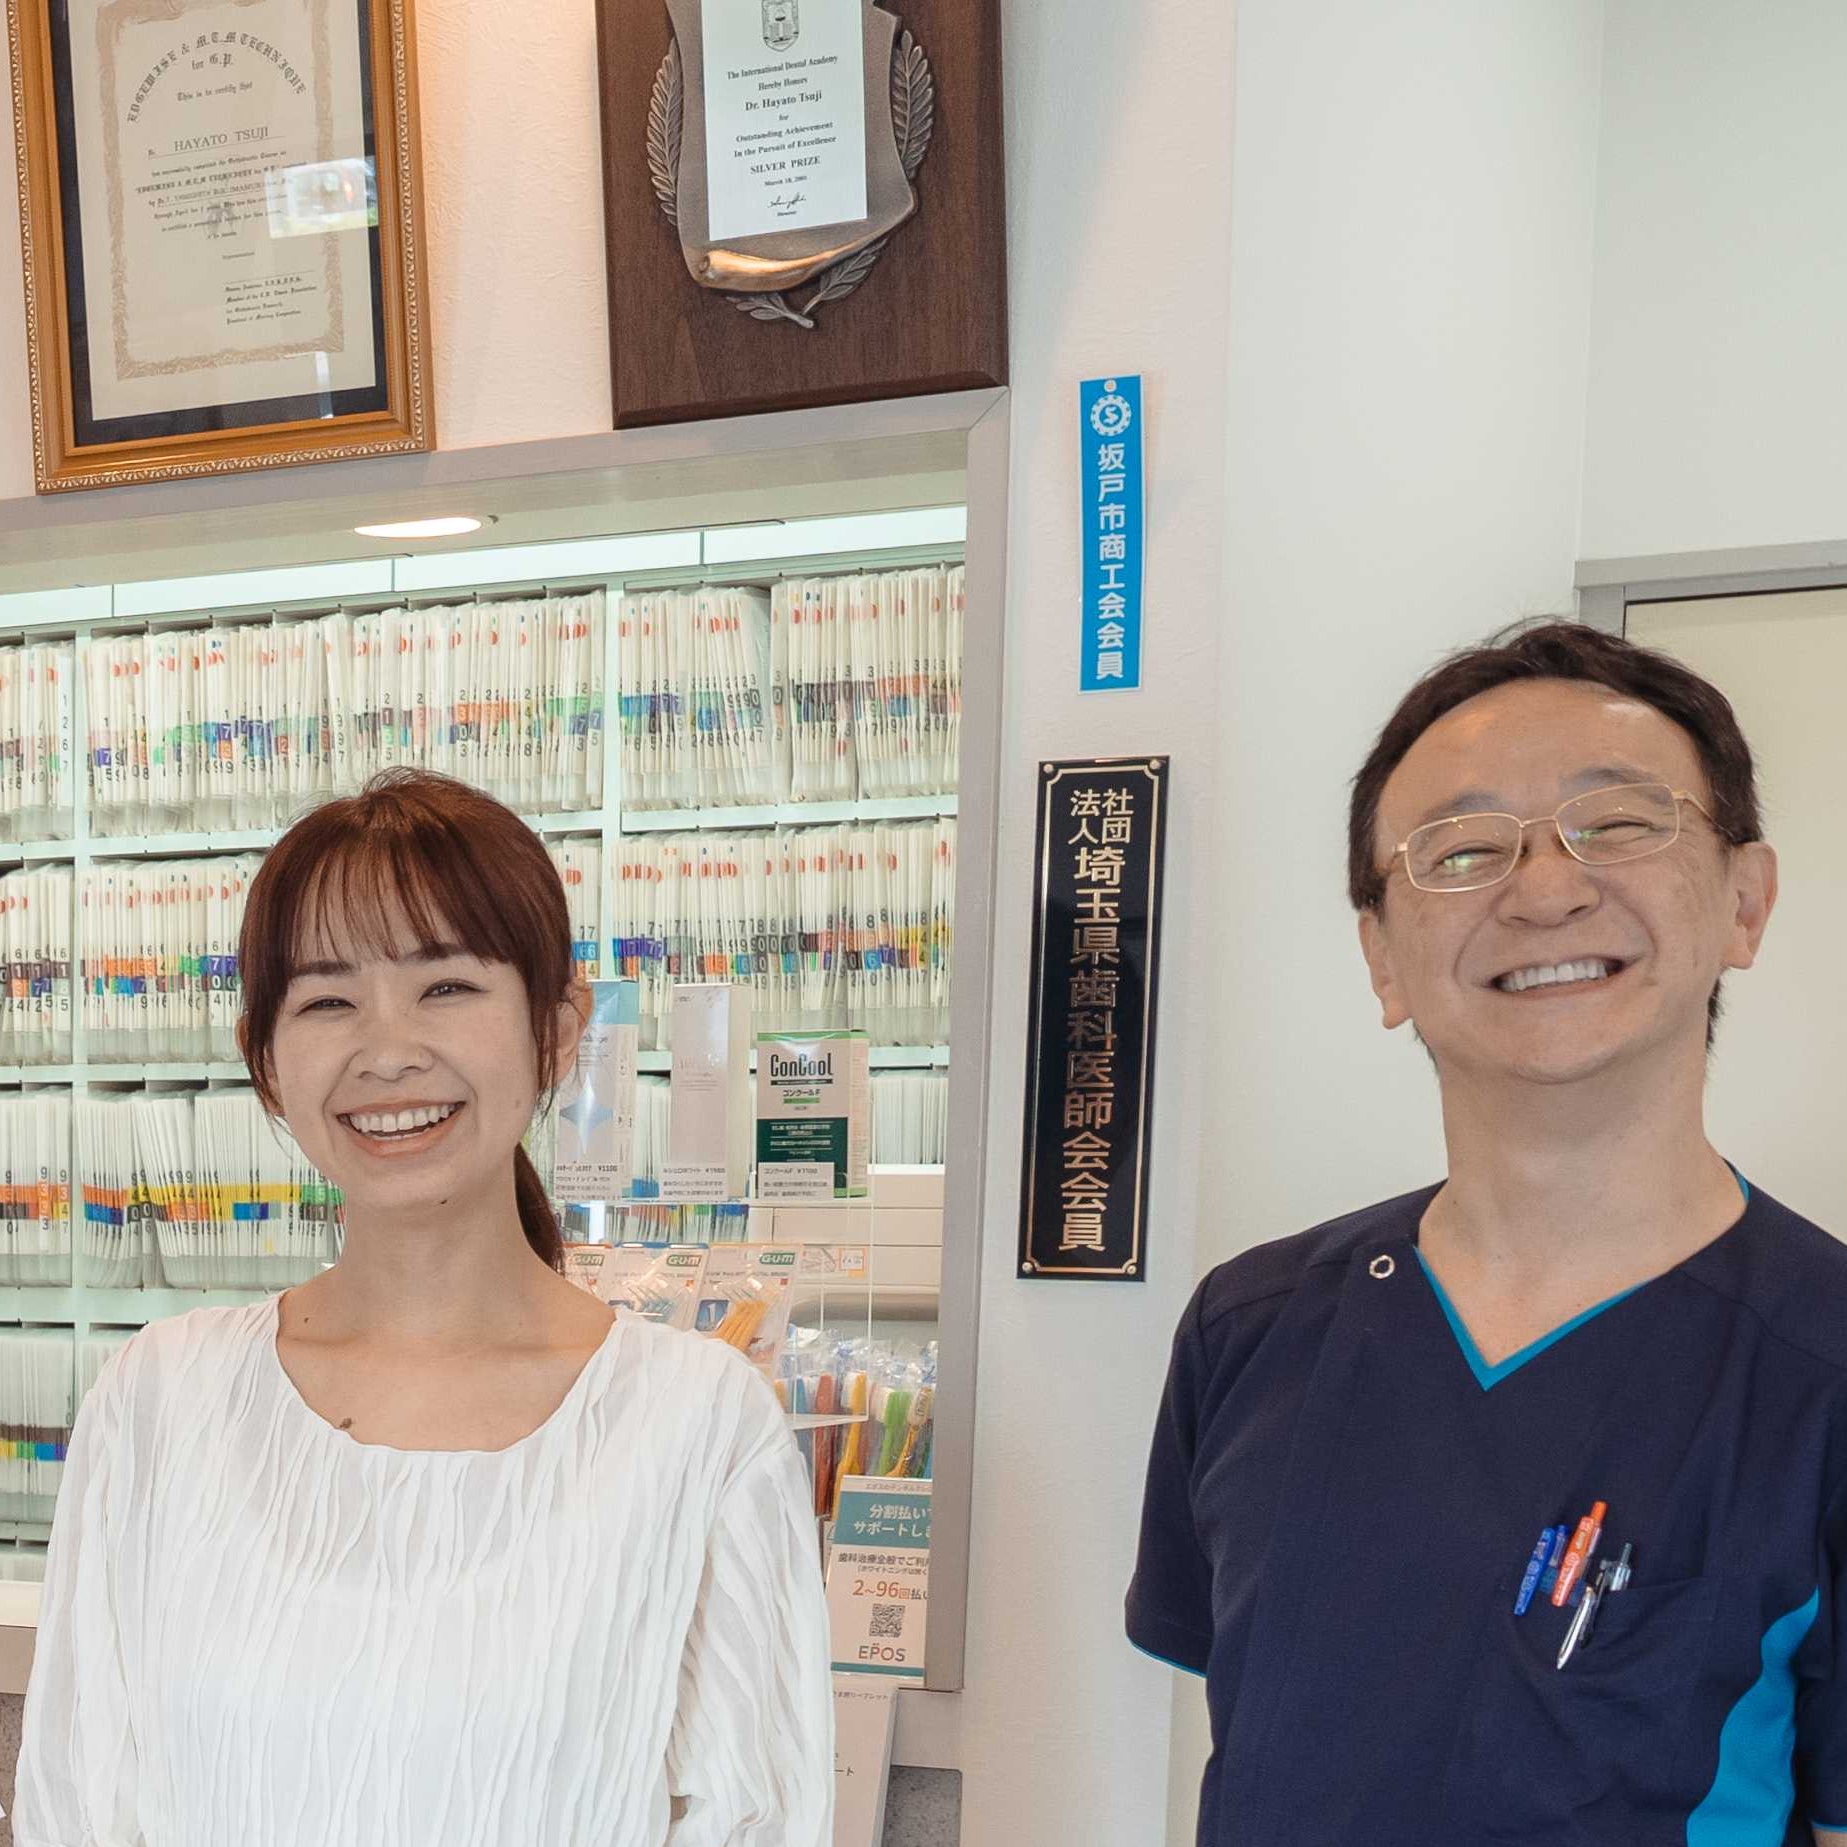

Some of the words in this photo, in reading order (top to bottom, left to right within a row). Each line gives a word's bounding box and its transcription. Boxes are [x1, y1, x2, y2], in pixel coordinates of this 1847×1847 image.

[745, 101, 760, 112] Dr.
[762, 96, 798, 109] Hayato
[798, 89, 823, 103] Tsuji
[173, 133, 229, 152] HAYATO
[234, 126, 270, 142] TSUJI
[784, 121, 834, 136] Achievement
[744, 147, 756, 157] the
[749, 160, 787, 175] SILVER
[789, 155, 822, 169] PRIZE
[1095, 442, 1126, 679] 坂戸市商工会会員
[1067, 788, 1101, 844] 法人
[1101, 788, 1134, 844] 社団
[1057, 845, 1125, 1252] 埼玉県歯科医師会会員
[770, 1052, 834, 1078] ConCool
[858, 1643, 907, 1662] EPOS
